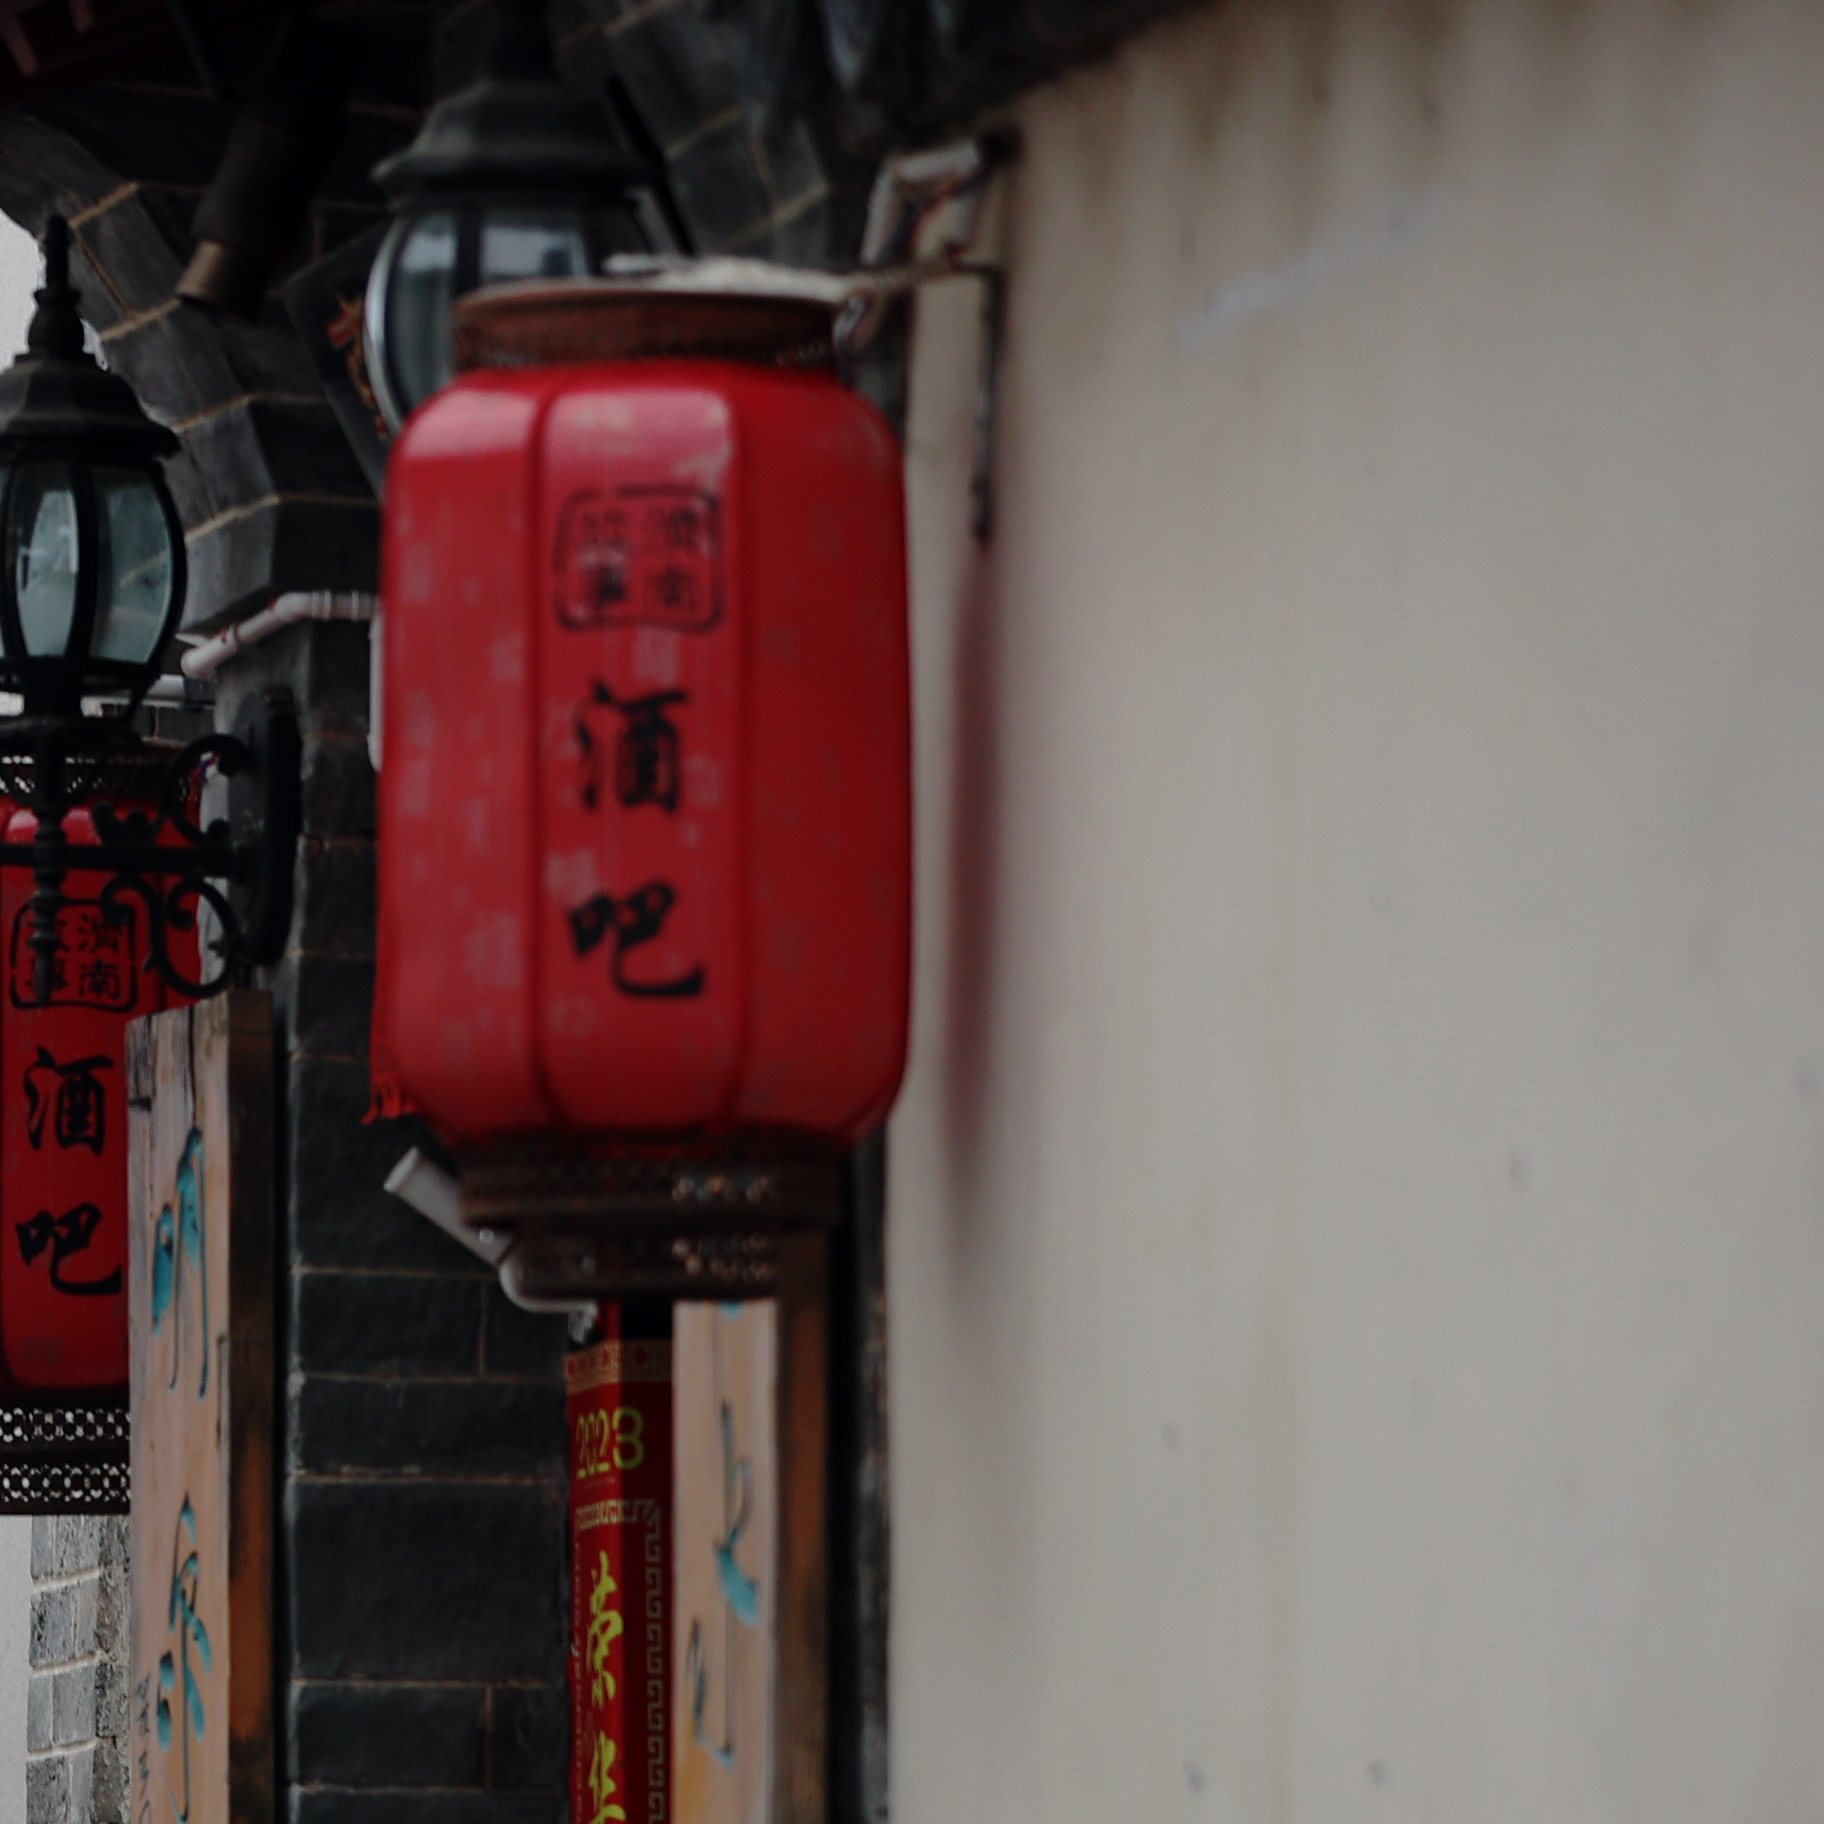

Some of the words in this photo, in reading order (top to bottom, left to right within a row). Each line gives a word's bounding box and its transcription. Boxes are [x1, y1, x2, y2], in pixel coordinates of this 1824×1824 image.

[565, 673, 706, 1000] 酒吧
[14, 1044, 123, 1297] 酒吧
[575, 1406, 645, 1479] 2023
